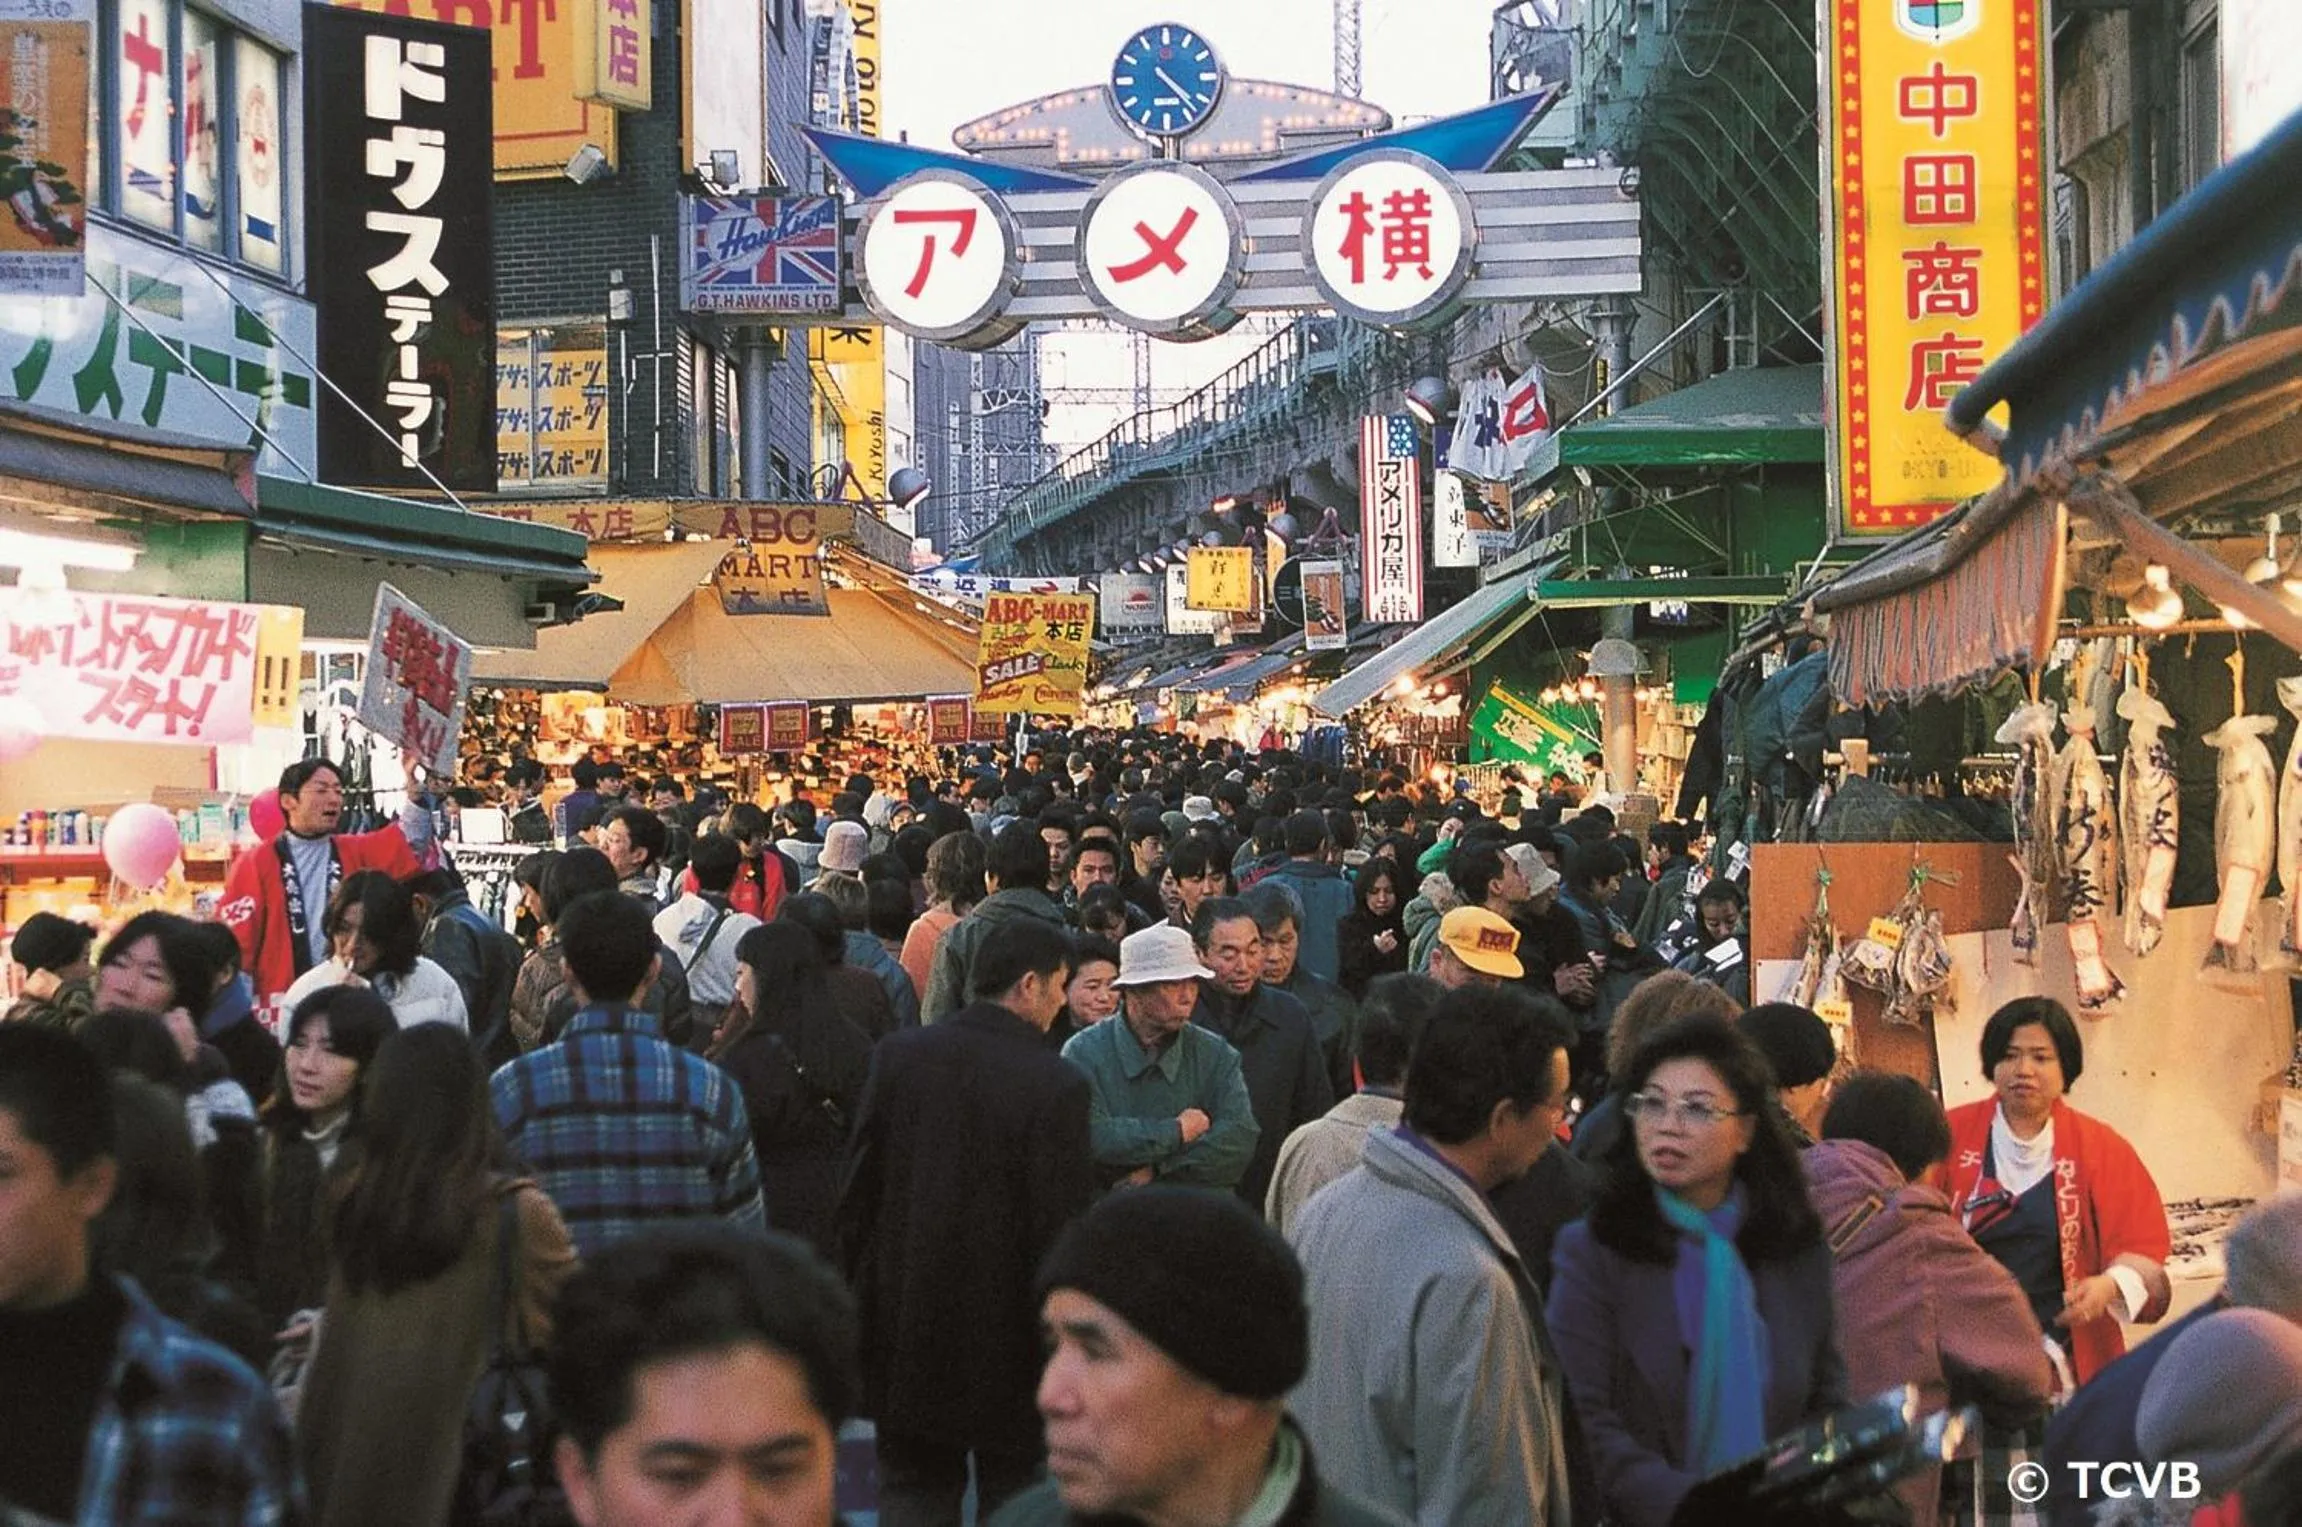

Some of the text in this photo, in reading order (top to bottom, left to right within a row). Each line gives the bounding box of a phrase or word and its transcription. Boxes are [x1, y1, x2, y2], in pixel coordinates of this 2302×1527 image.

[1899, 61, 1984, 412] 中田商店
[716, 506, 817, 546] ABC
[1378, 460, 1404, 581] アメリカ屋
[719, 554, 819, 579] MART
[986, 597, 1090, 624] ABC-MART
[1046, 620, 1084, 641] 本店
[984, 654, 1040, 685] SALE
